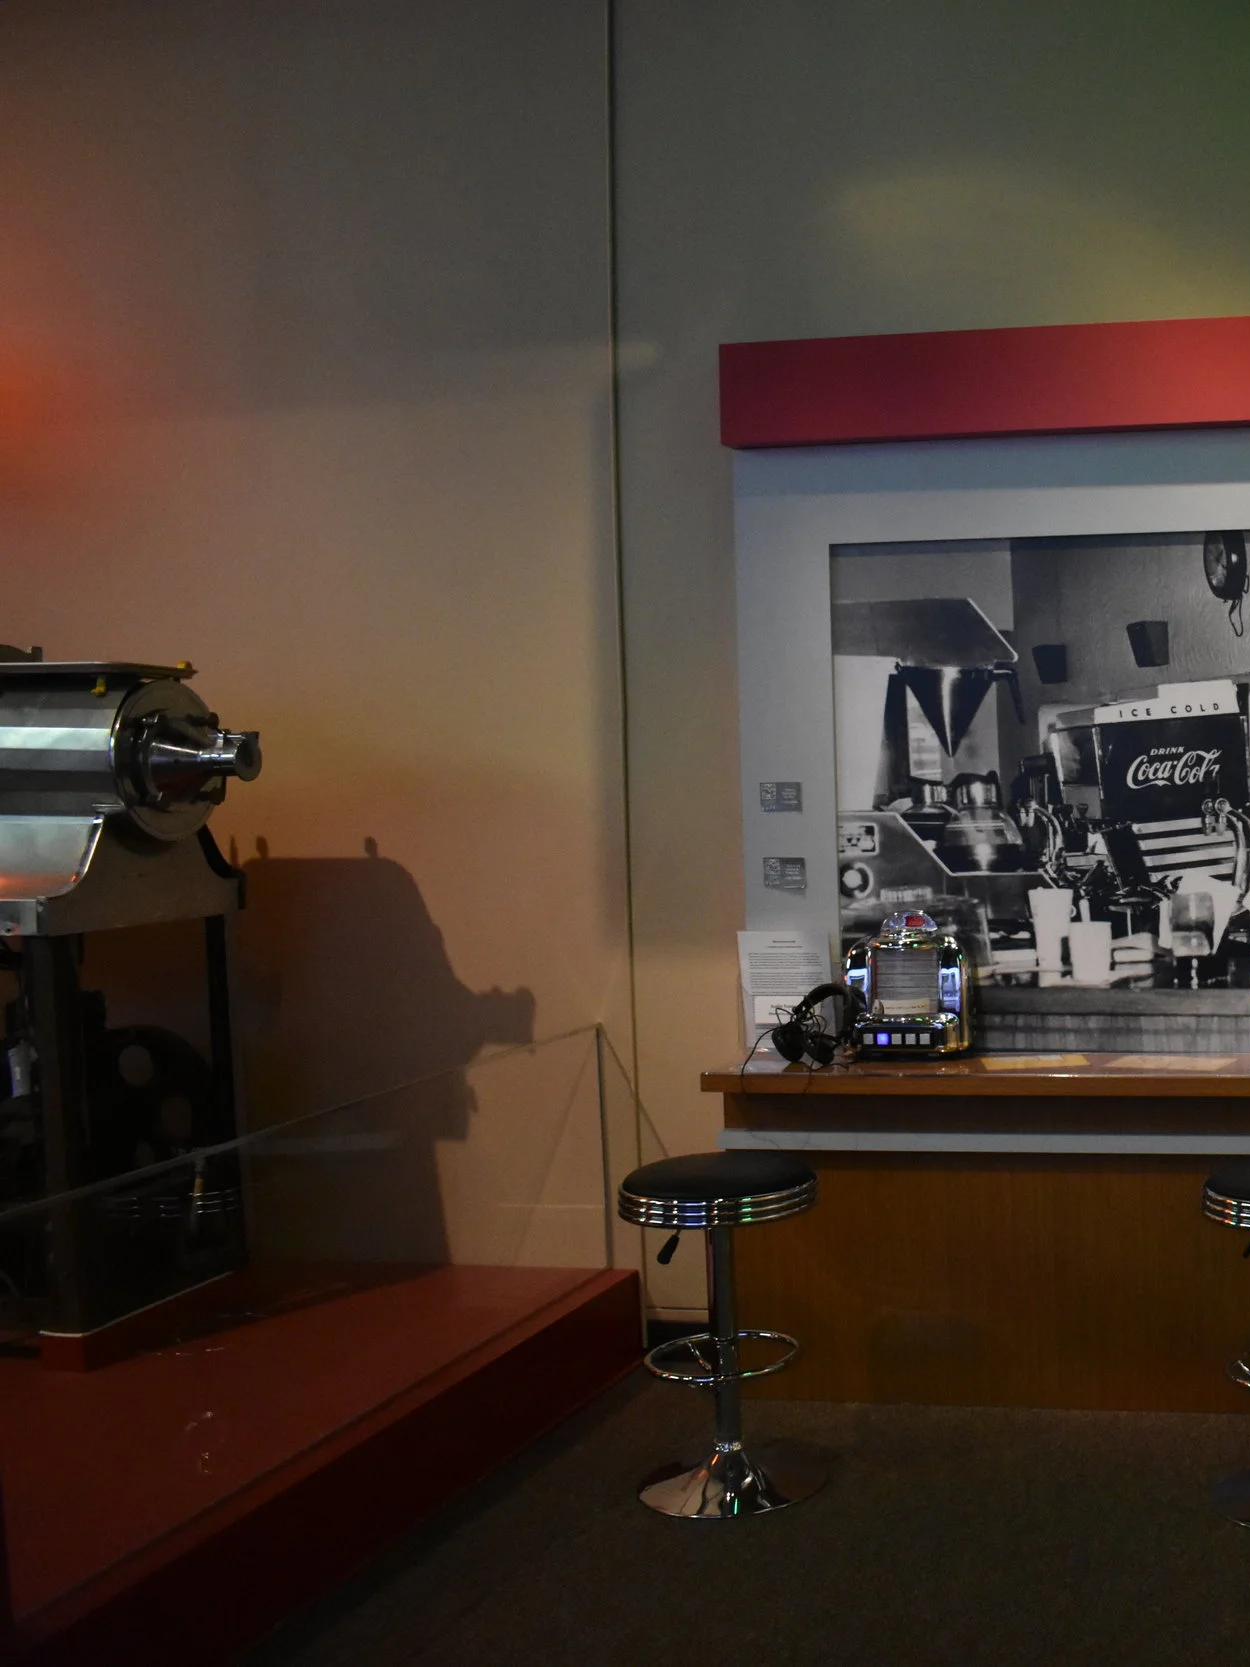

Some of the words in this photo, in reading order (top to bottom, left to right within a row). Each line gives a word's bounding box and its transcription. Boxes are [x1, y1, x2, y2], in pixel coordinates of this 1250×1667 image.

[1120, 708, 1152, 718] ICE
[1171, 703, 1219, 714] COLD
[1150, 746, 1185, 756] DRINK
